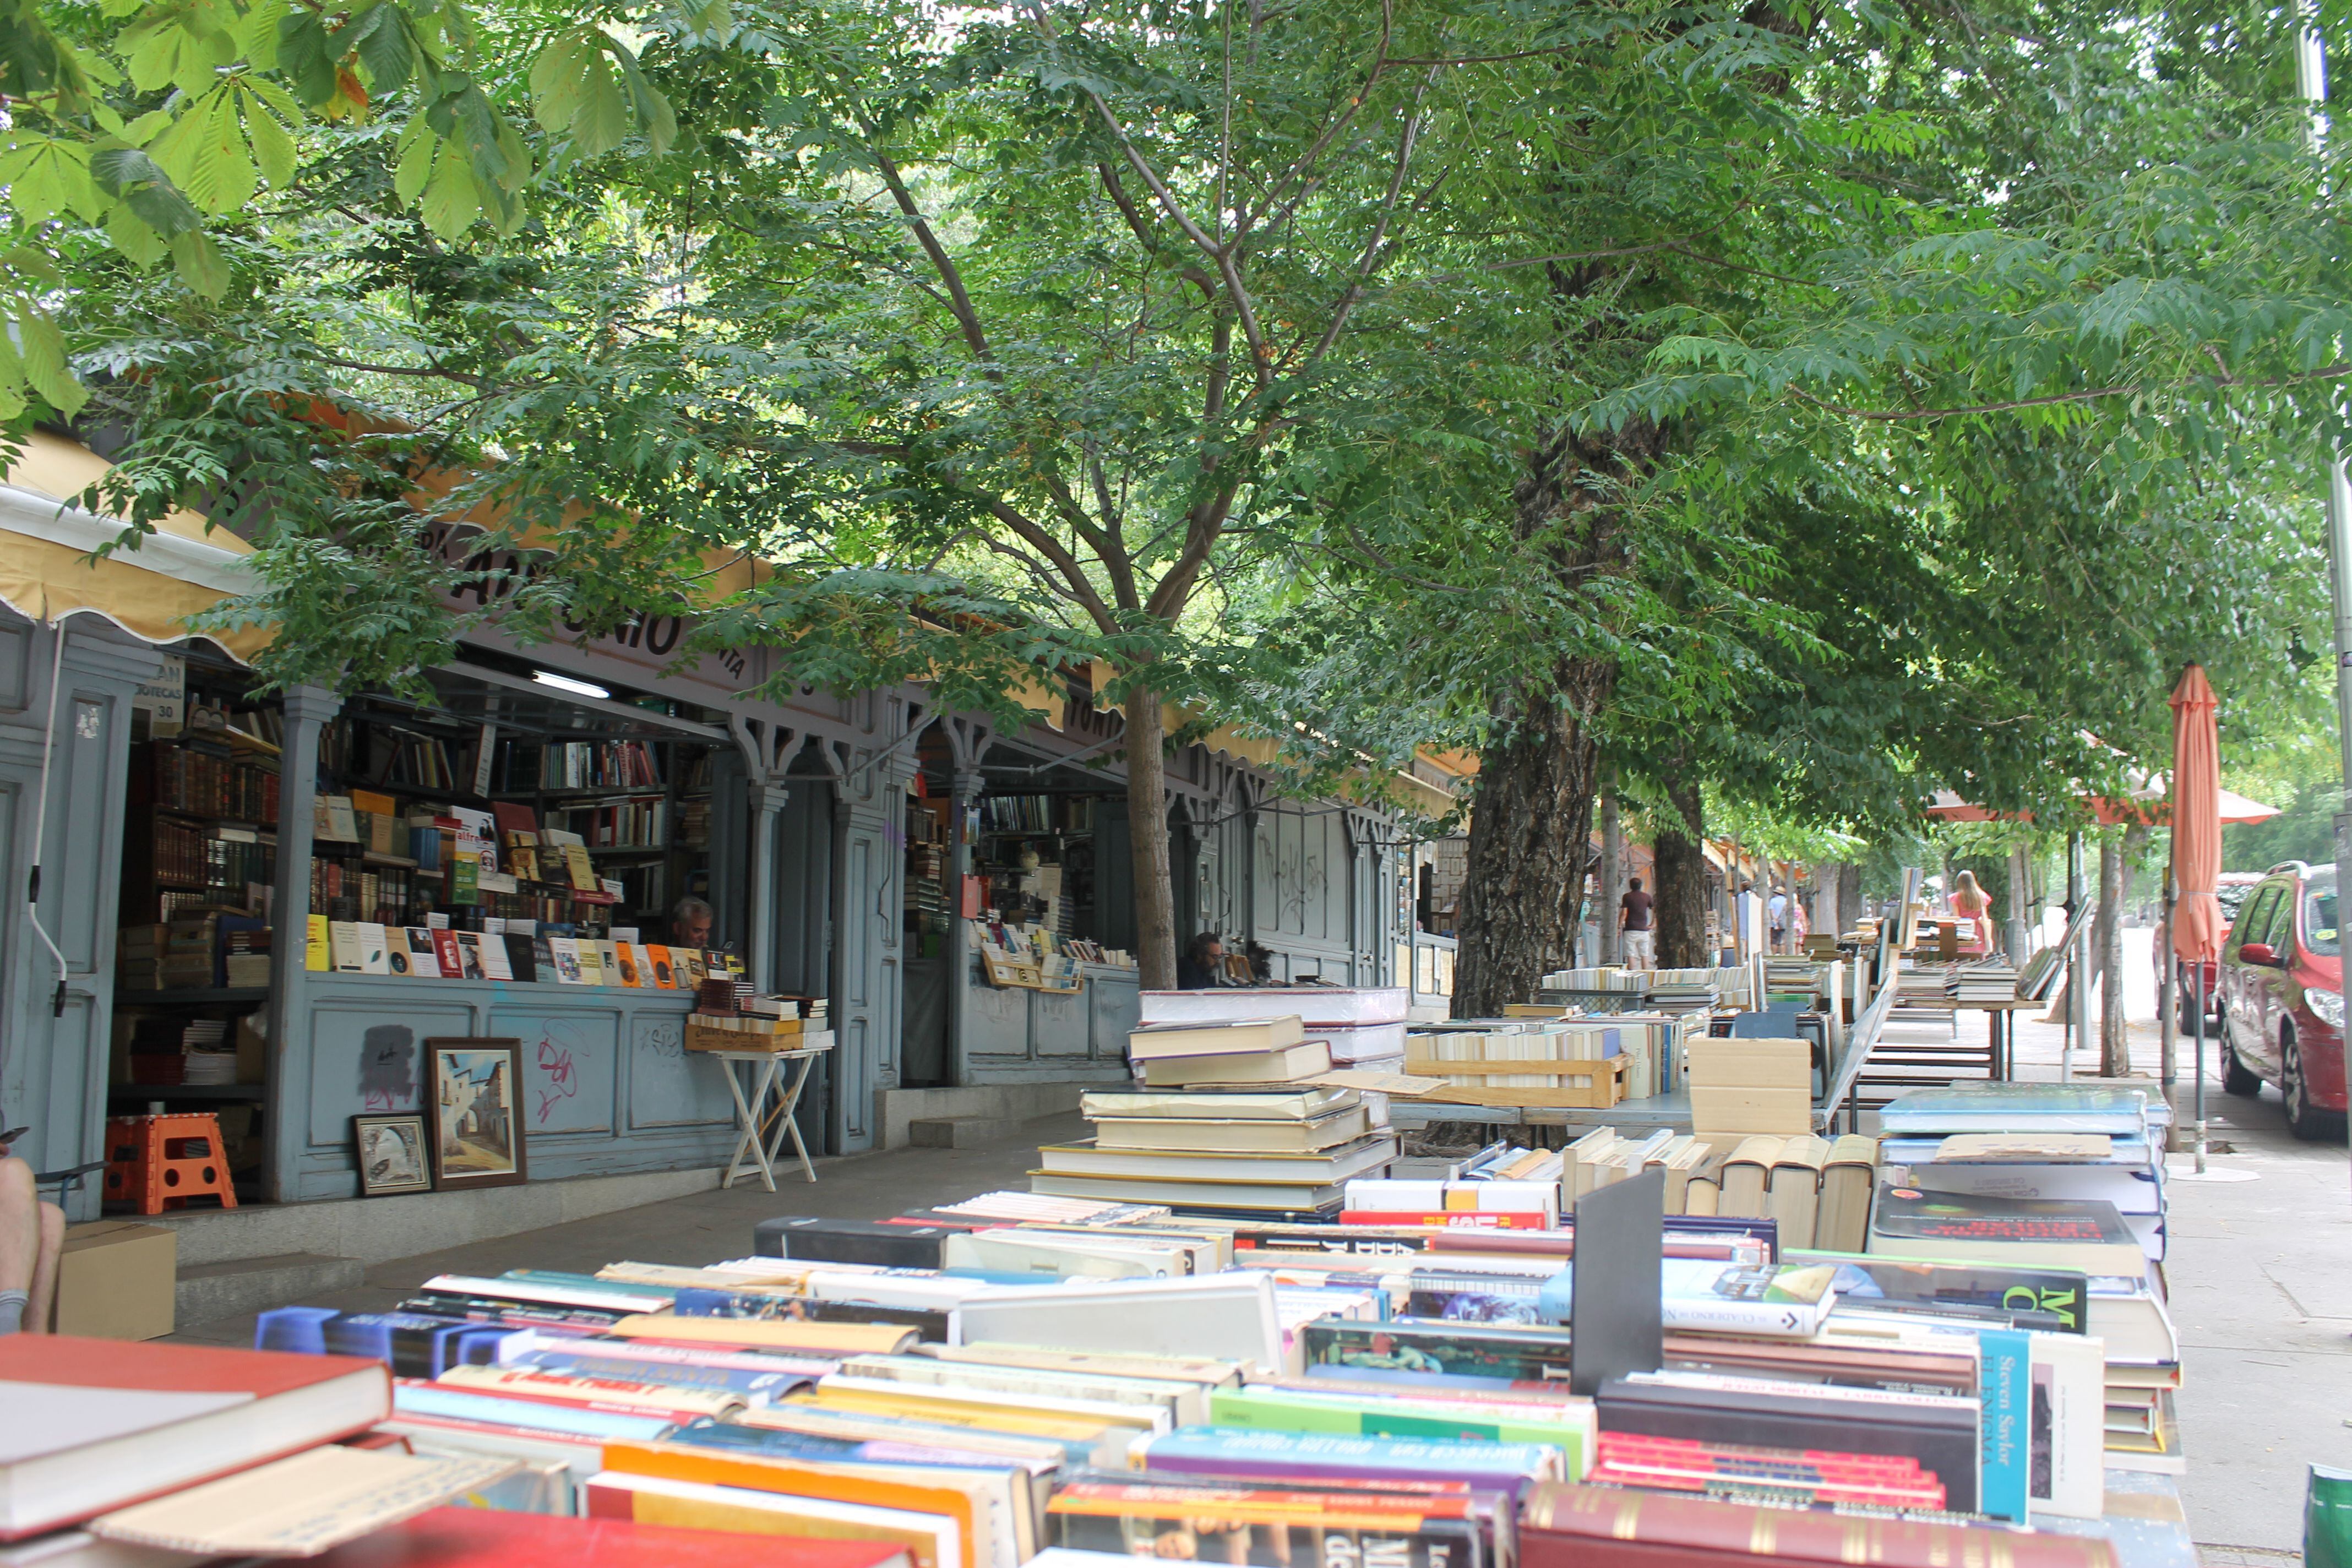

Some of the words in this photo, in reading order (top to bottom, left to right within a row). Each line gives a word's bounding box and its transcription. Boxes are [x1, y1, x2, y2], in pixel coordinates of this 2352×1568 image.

[450, 547, 681, 656] ANONIO
[1998, 1355, 2016, 1409] Steven
[1997, 1411, 2016, 1467] Saylor
